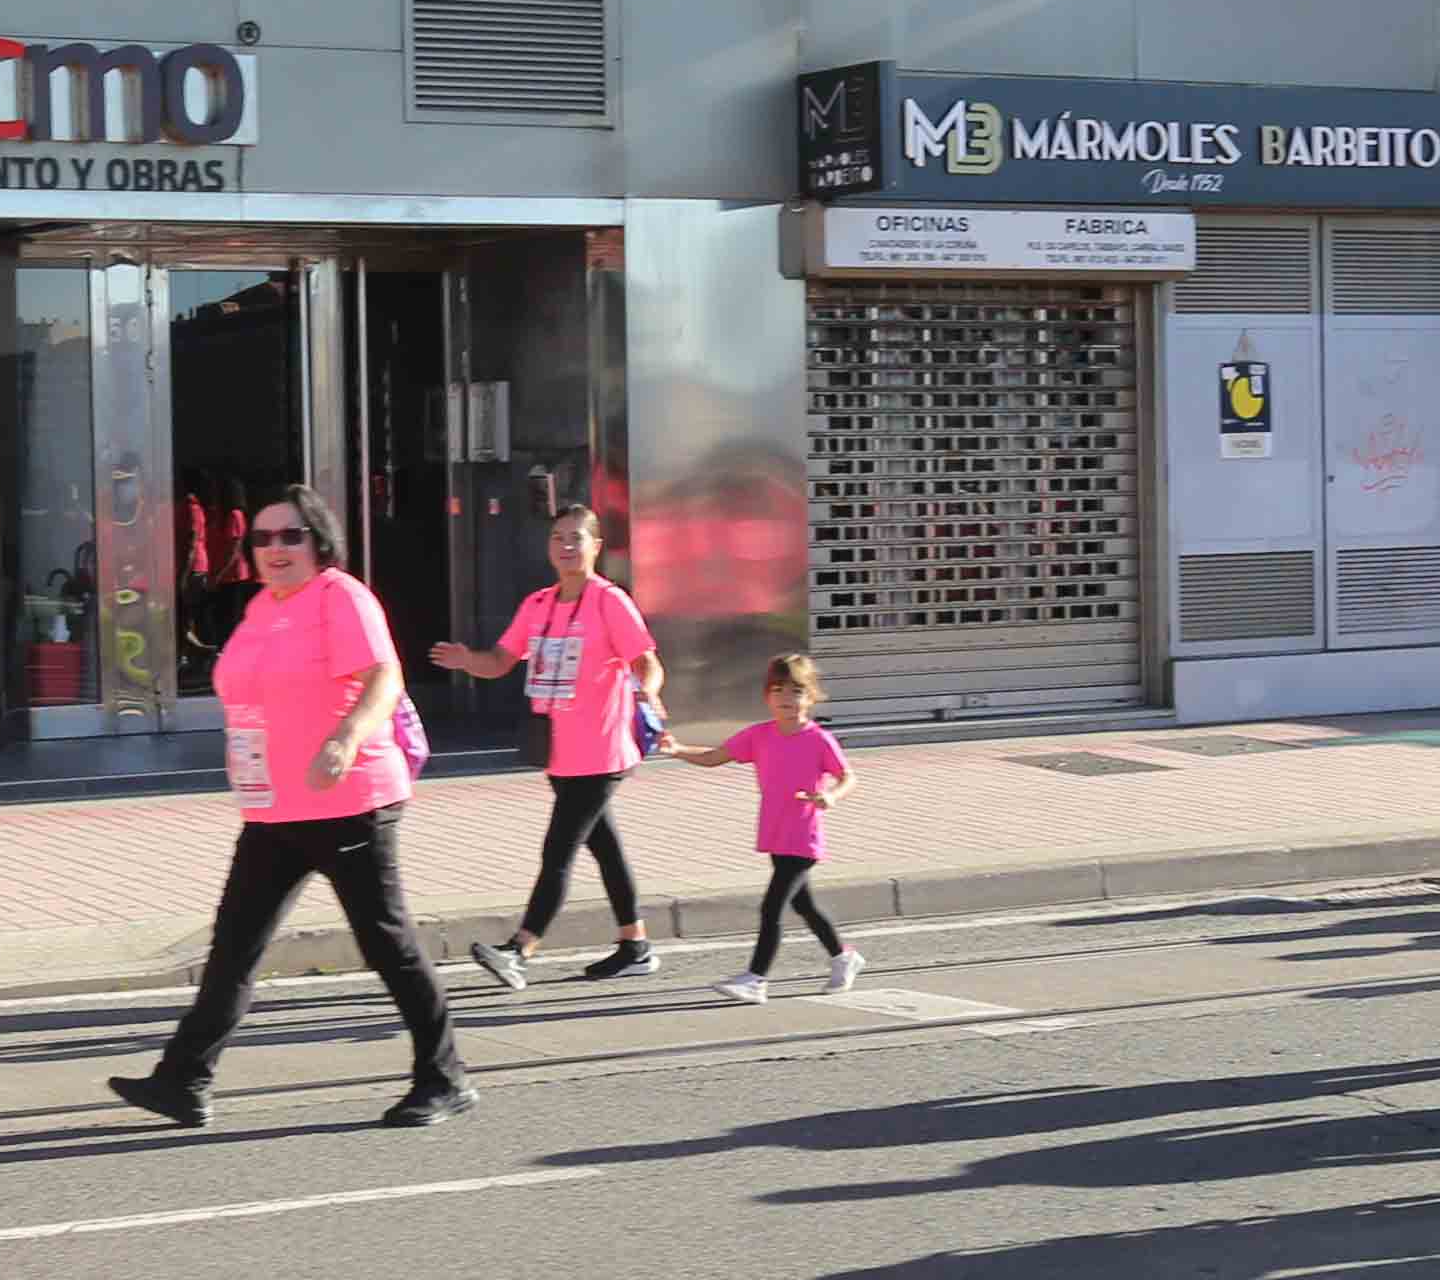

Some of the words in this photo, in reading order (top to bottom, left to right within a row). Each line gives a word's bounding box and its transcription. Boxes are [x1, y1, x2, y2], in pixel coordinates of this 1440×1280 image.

[1012, 110, 1242, 165] MÁRMOLES
[63, 157, 94, 190] Y
[105, 158, 225, 192] OBRAS
[876, 214, 970, 233] OFICINAS
[1065, 218, 1149, 236] FABRICA
